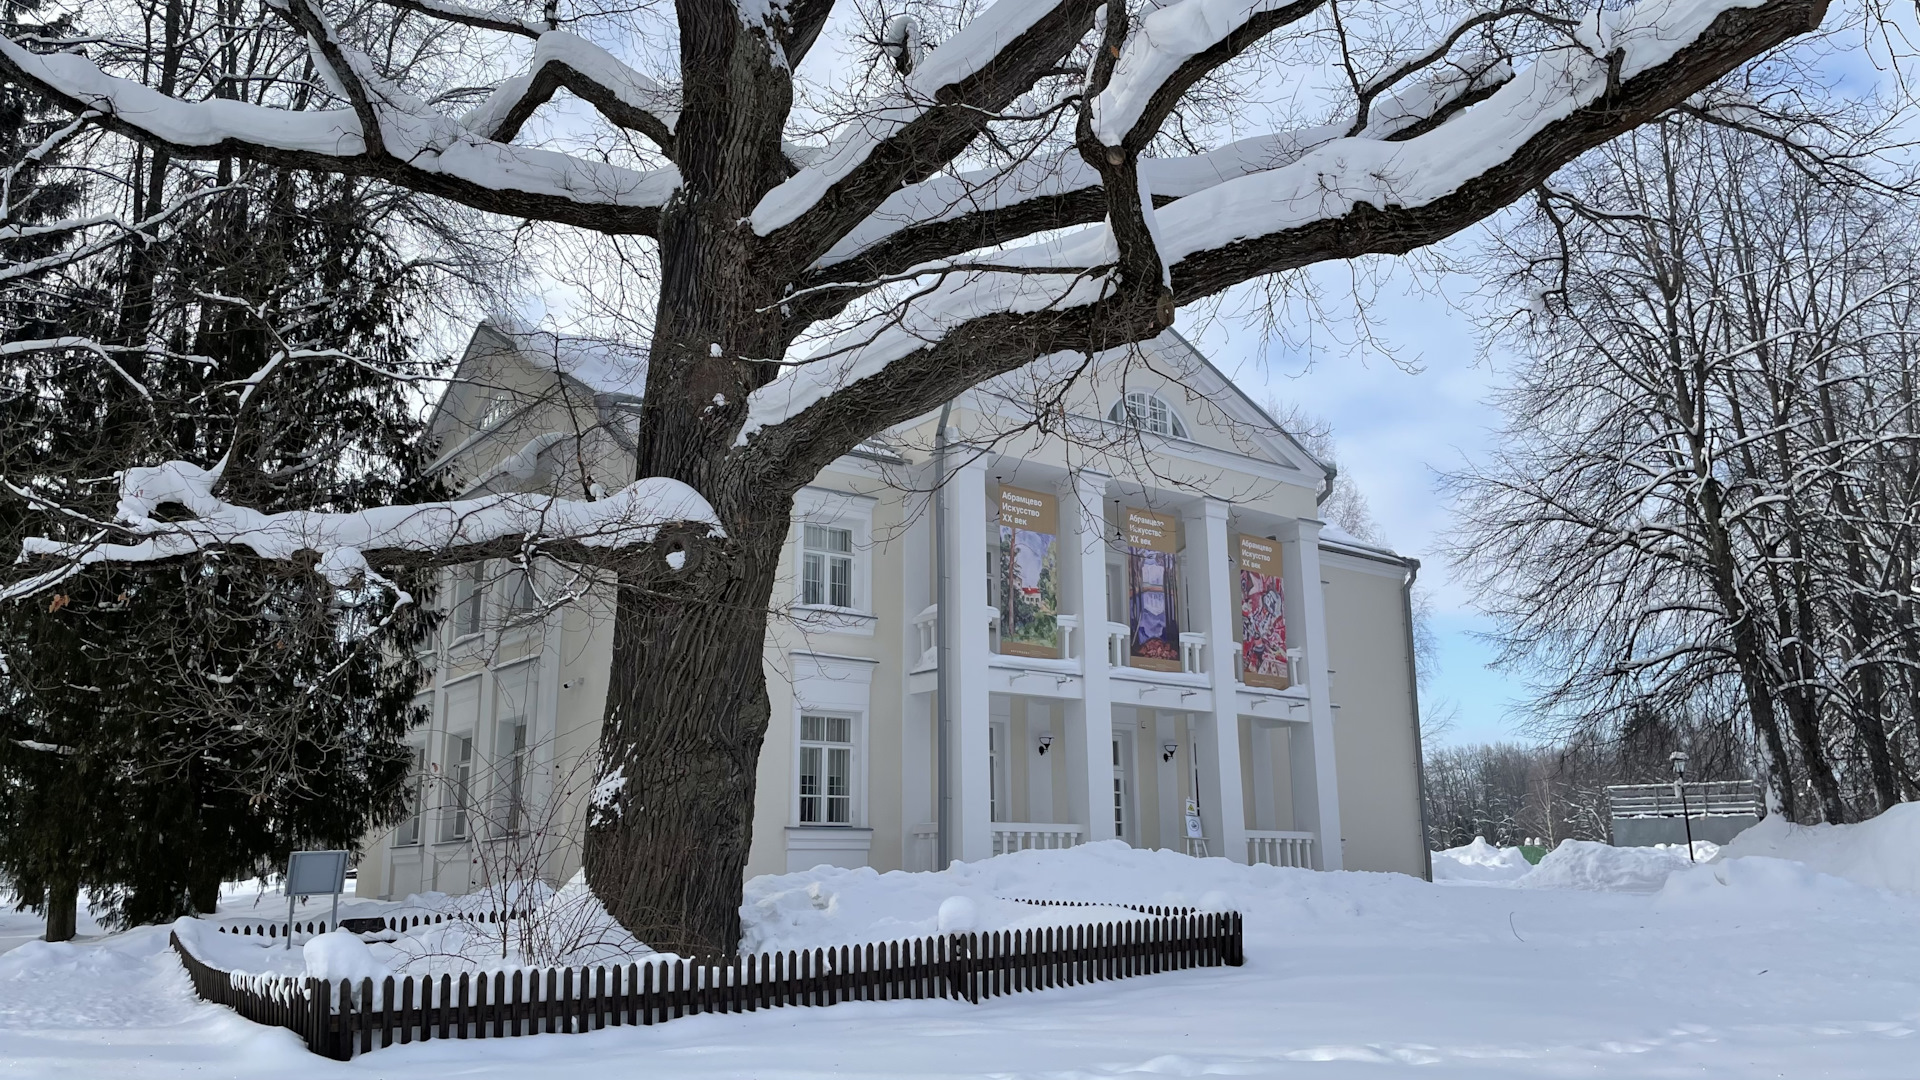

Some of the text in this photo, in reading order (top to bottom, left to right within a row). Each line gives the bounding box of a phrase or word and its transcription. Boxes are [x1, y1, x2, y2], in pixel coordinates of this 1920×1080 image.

[1002, 491, 1042, 507] Абрамцево
[1002, 502, 1040, 517] Искусство
[1014, 517, 1027, 526] век
[1241, 539, 1272, 553] Абрамцево
[1241, 549, 1270, 562] Искусство
[1250, 562, 1261, 570] век
